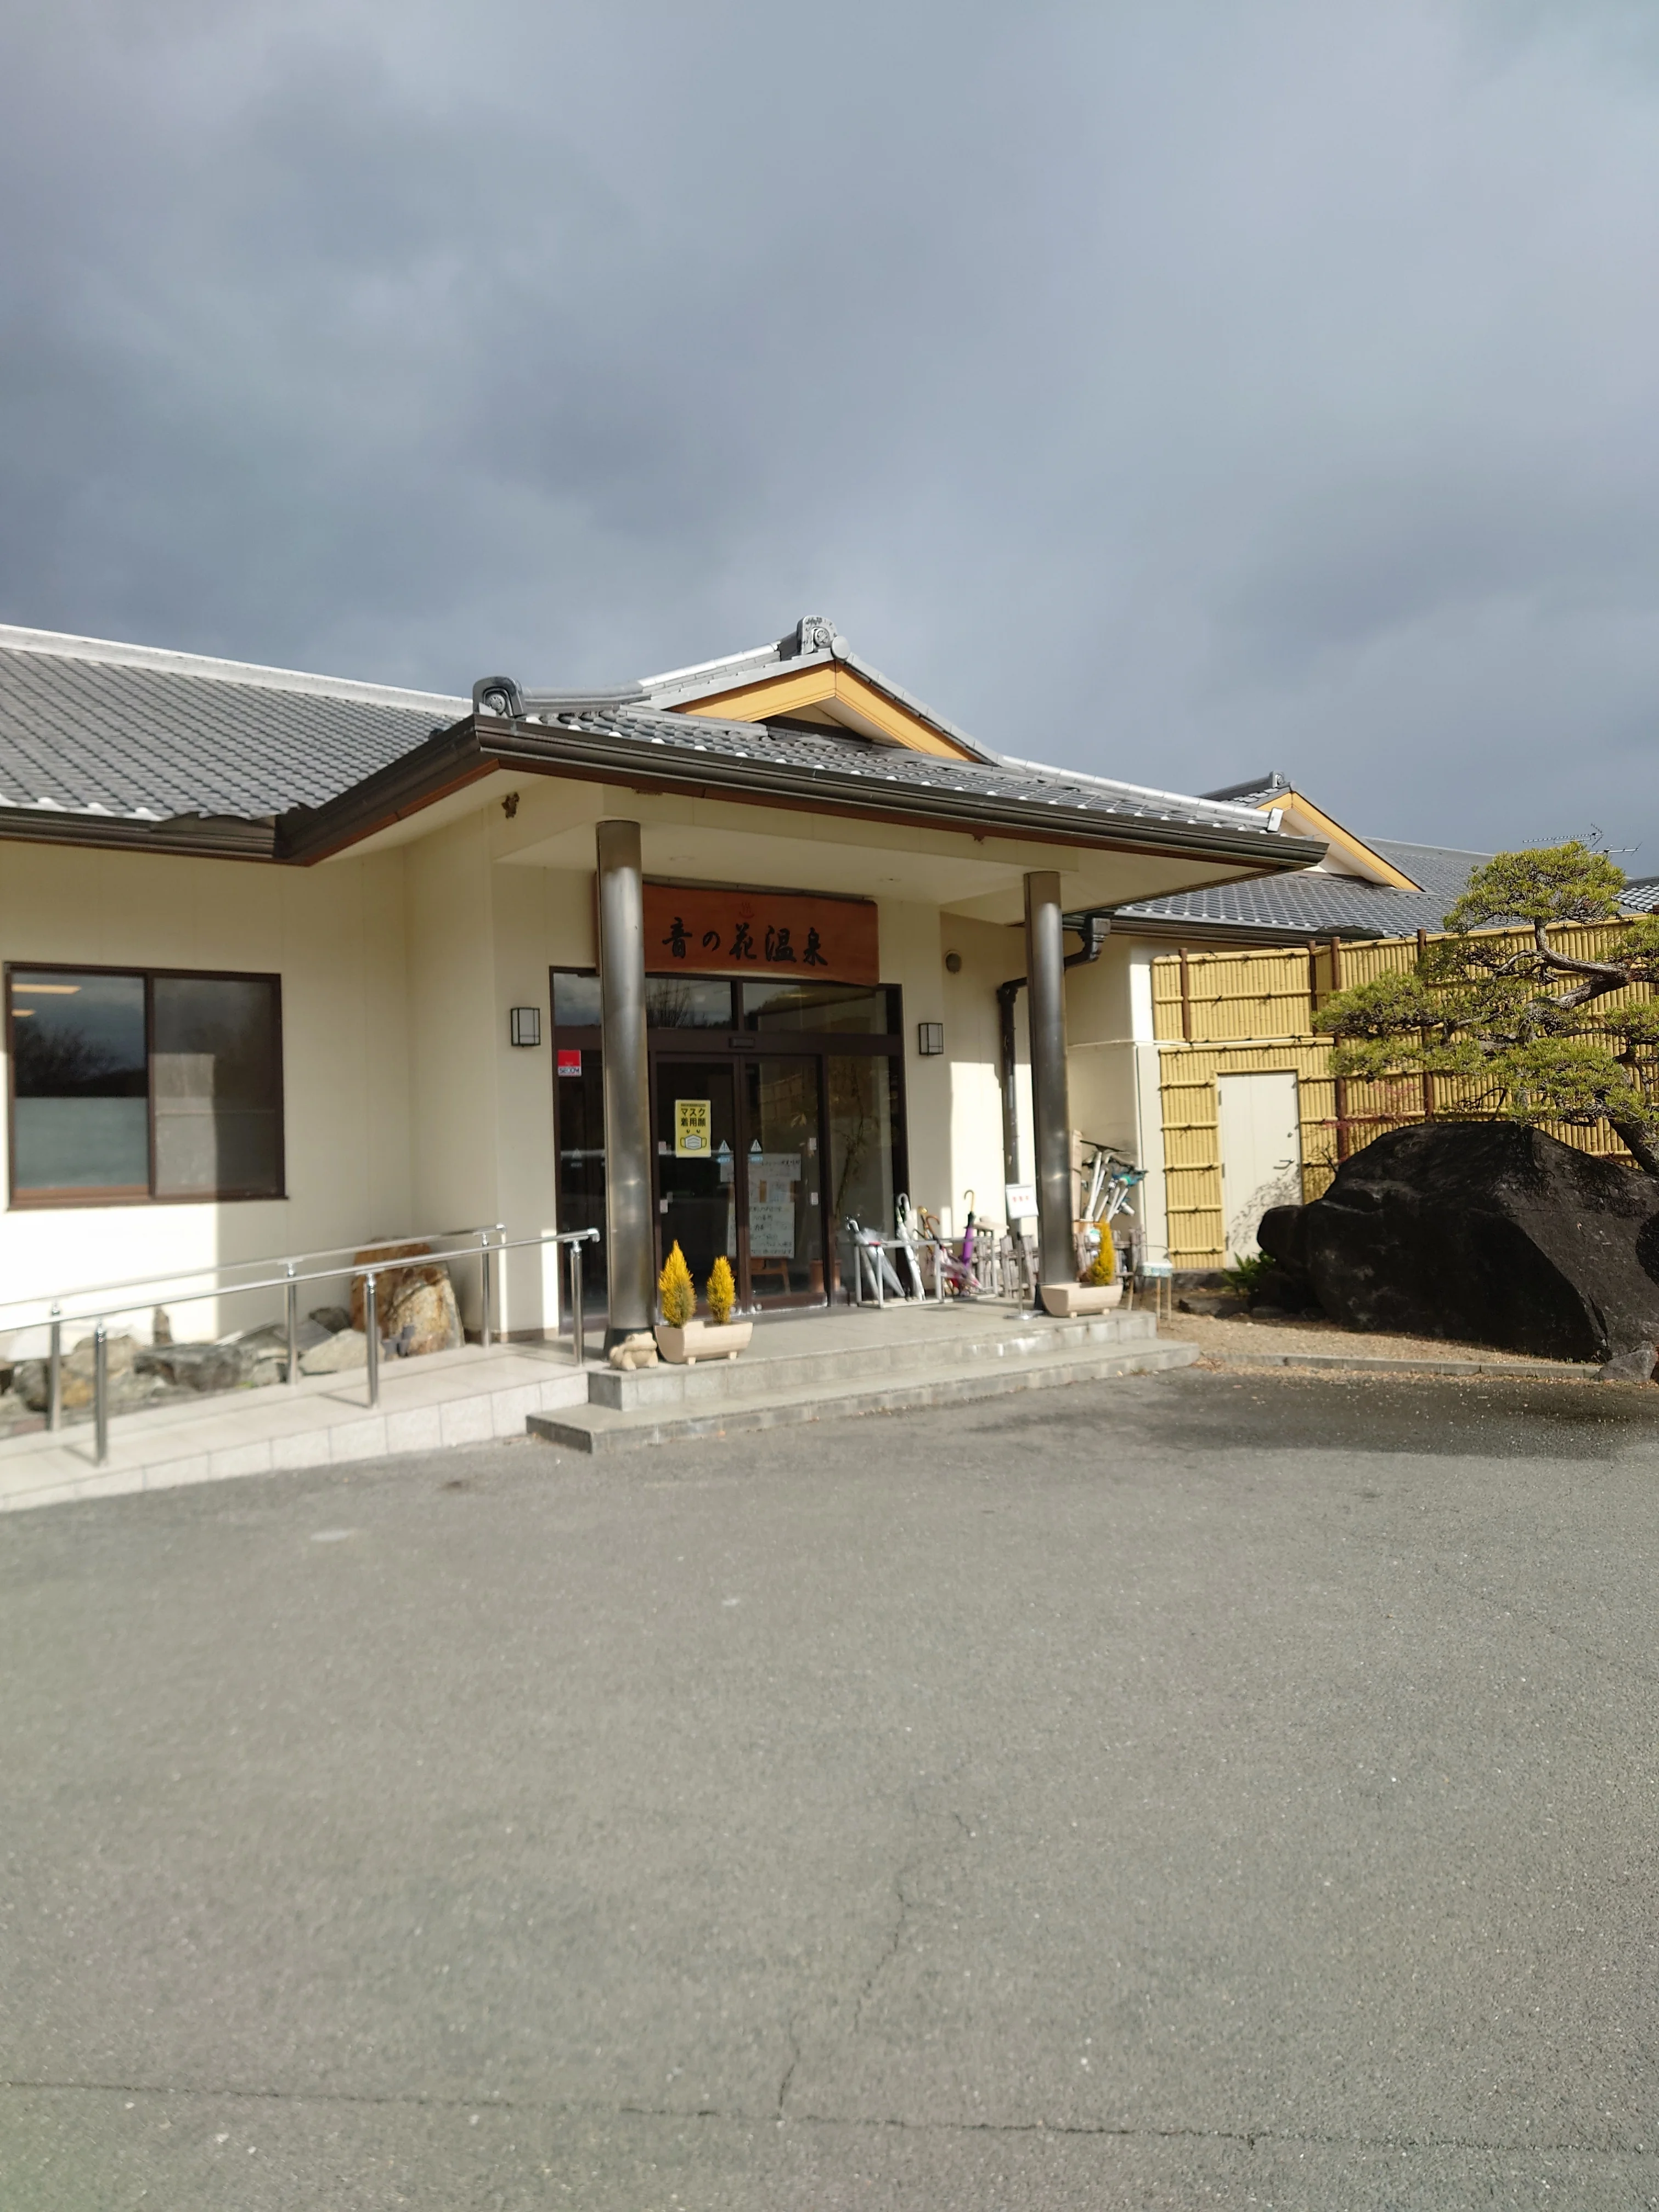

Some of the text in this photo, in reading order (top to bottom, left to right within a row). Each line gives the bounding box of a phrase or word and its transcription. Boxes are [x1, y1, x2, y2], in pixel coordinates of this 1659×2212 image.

[662, 916, 828, 966] 音の花温泉
[681, 1108, 706, 1117] マスク
